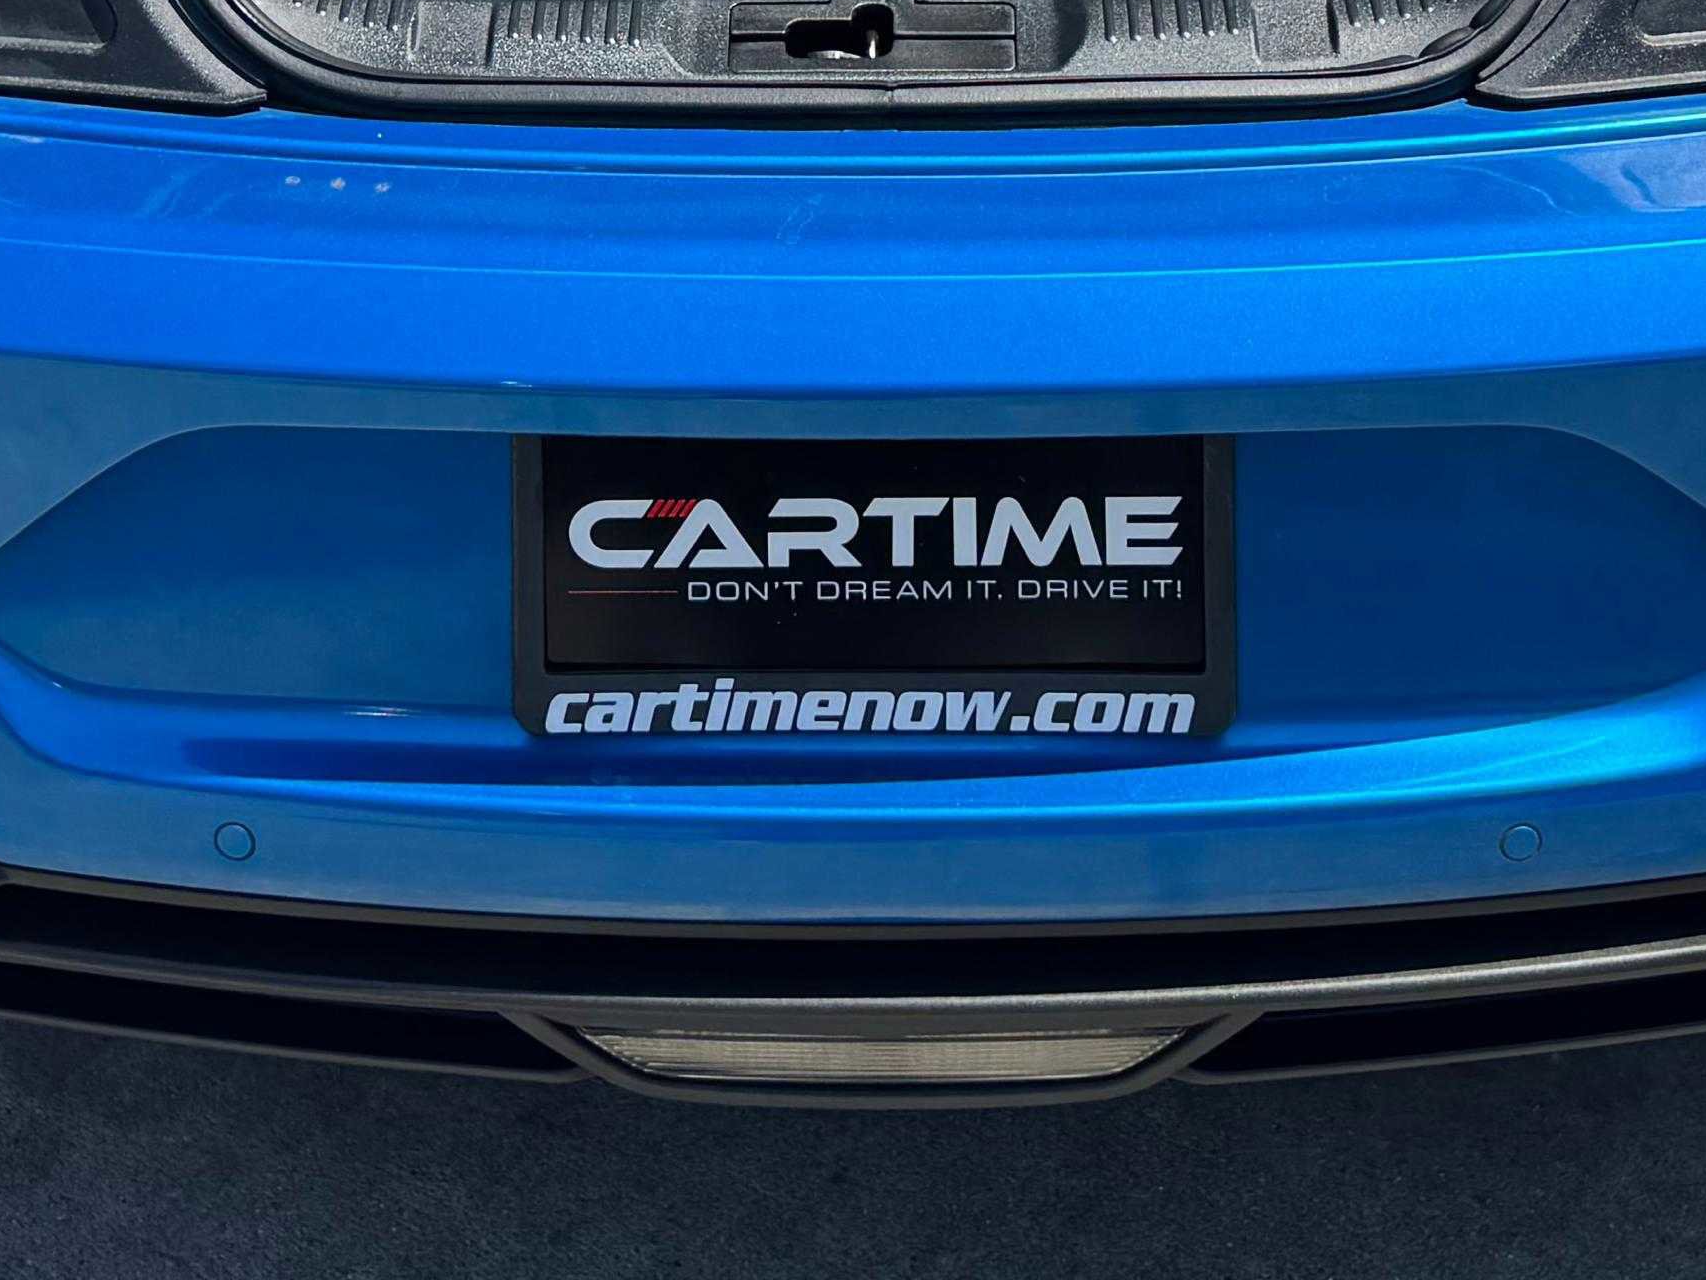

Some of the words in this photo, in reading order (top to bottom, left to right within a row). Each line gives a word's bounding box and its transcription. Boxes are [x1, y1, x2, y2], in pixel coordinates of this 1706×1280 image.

[567, 496, 1183, 569] CARTIME
[687, 580, 803, 602] DON'T
[816, 579, 953, 602] DREAM
[967, 579, 1003, 601] IT.
[1017, 578, 1130, 600] DRIVE
[1143, 578, 1183, 600] IT!
[544, 677, 1196, 735] cartimenow.com
